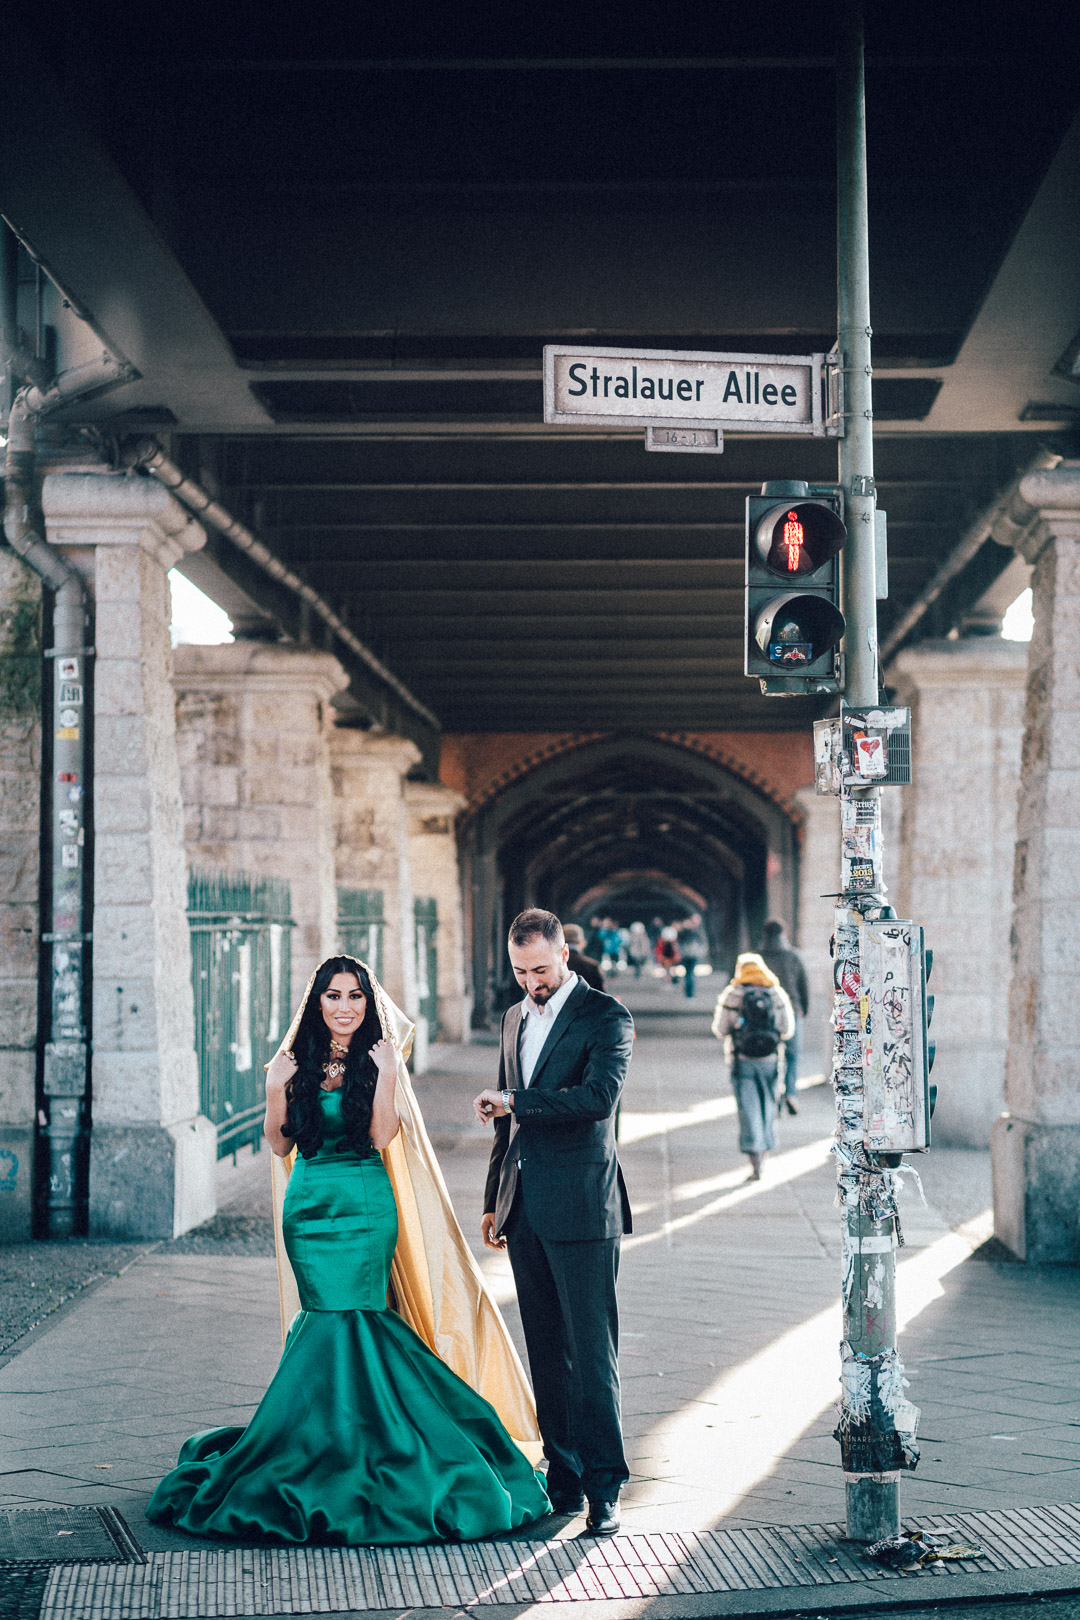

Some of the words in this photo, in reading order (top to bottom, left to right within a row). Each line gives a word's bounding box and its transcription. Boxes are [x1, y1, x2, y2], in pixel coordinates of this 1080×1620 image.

[568, 363, 704, 401] Stralauer
[722, 371, 797, 406] Allee
[666, 431, 677, 443] 16
[860, 478, 866, 495] 1
